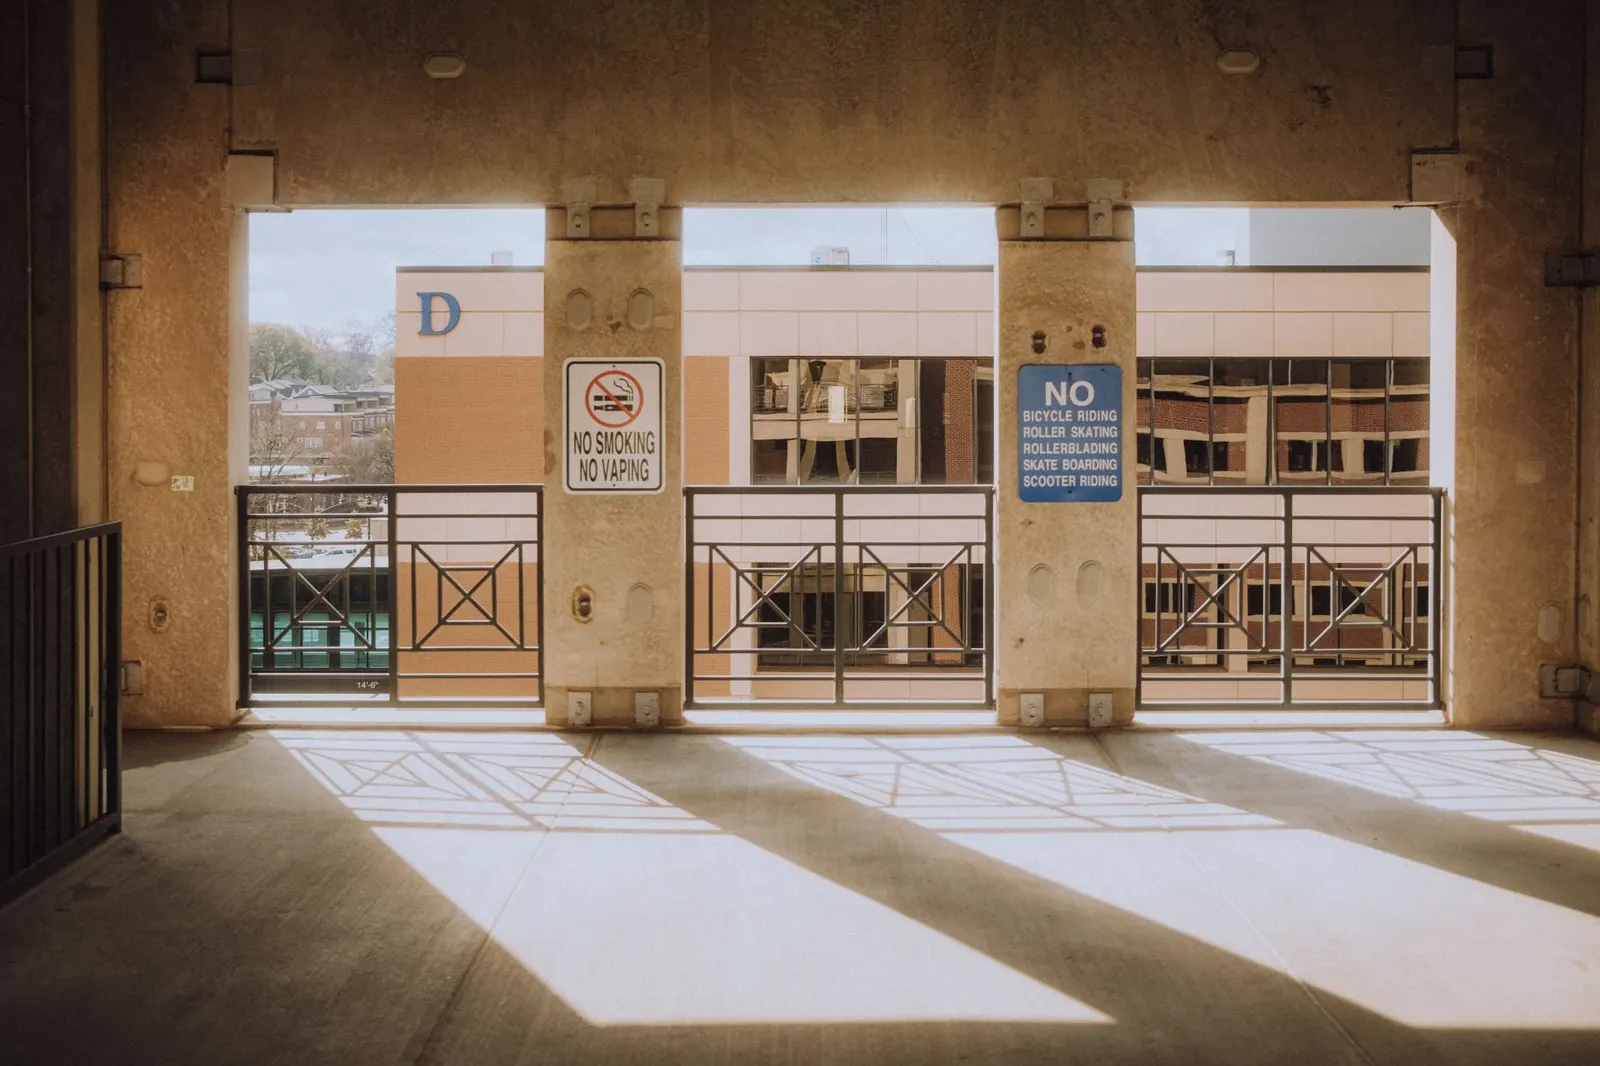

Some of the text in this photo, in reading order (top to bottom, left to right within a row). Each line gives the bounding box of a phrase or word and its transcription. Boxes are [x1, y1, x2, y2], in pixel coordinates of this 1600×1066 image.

[416, 291, 461, 336] D
[1045, 380, 1095, 406] NO
[1023, 409, 1118, 422] BICYCLE RIDING
[1023, 426, 1118, 438] ROLLER SKATING
[573, 430, 656, 455] NO SMOKING
[1023, 442, 1118, 454] ROLLERBLADING
[579, 458, 650, 482] NO VAPING
[1023, 458, 1118, 471] SKATE BOARDING
[1023, 475, 1118, 487] SCOOTER RIDING
